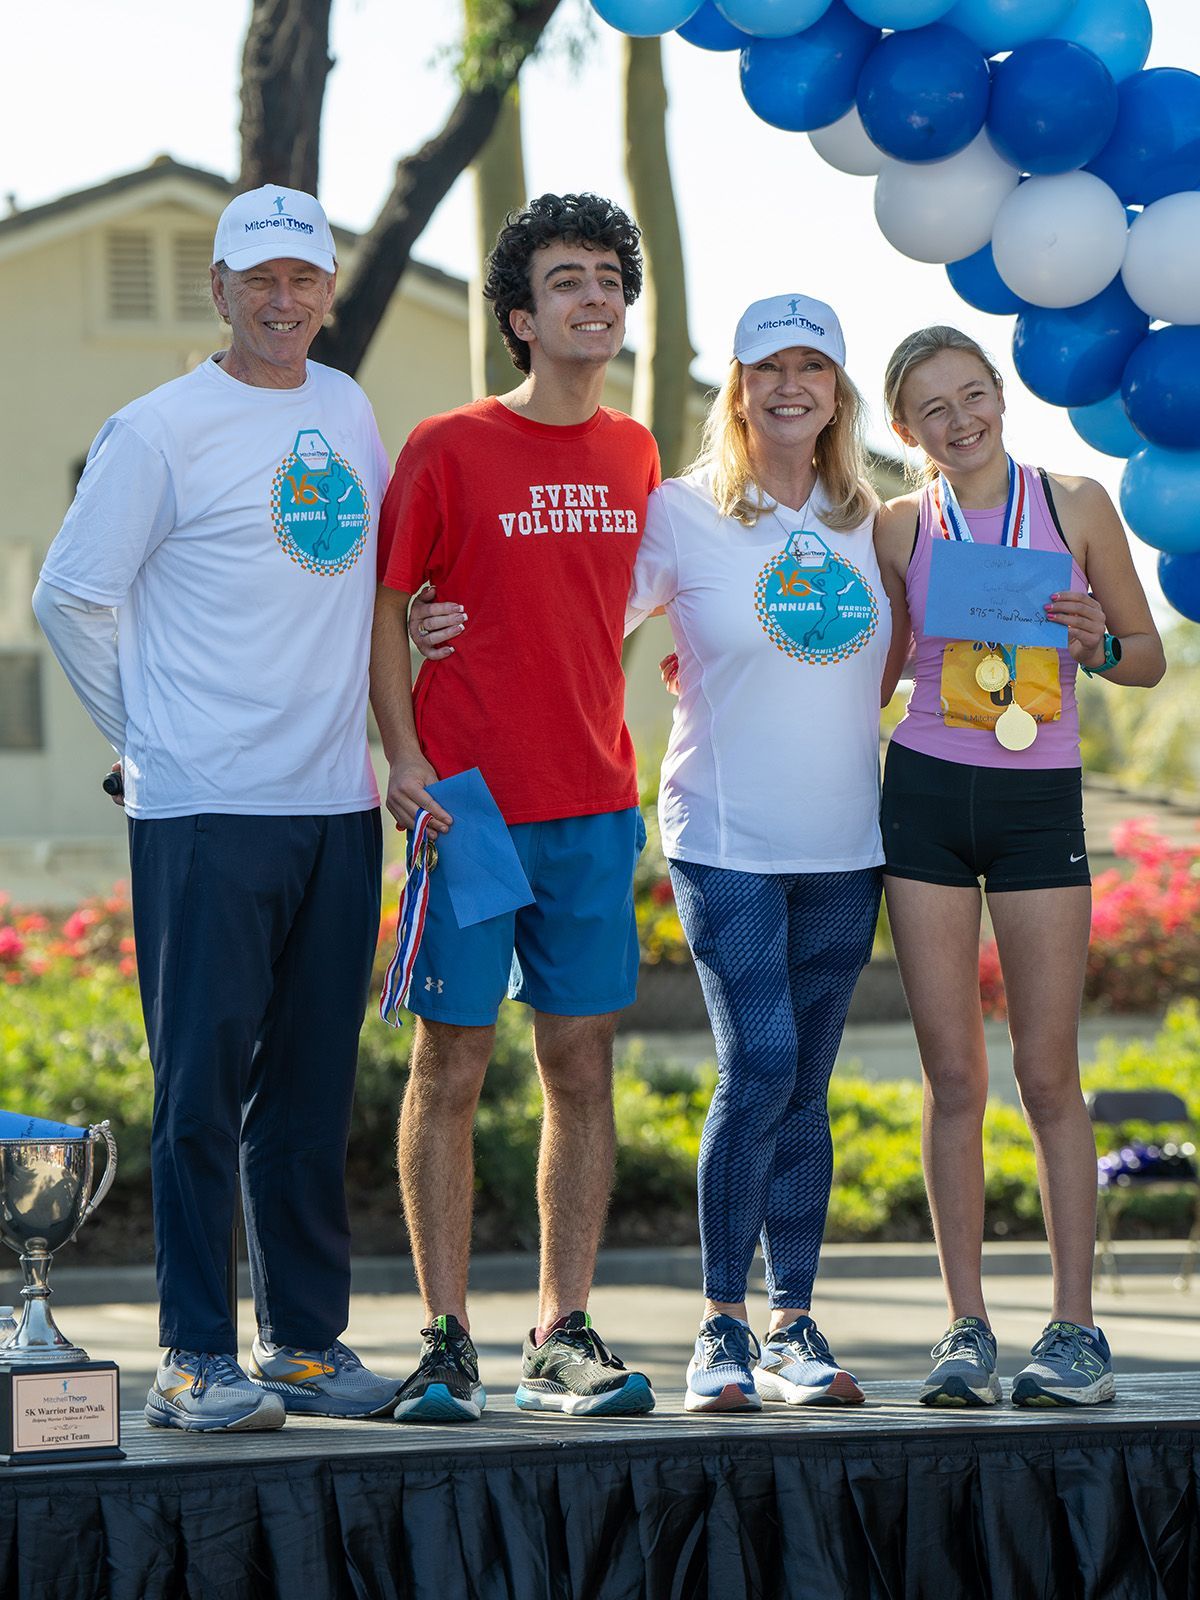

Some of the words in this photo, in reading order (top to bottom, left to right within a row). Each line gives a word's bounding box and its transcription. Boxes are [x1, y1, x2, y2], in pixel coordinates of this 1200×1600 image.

[245, 218, 285, 232] Mitchell
[286, 218, 314, 234] Thorp
[757, 317, 798, 331] Mitchell
[799, 318, 825, 336] Thorp
[287, 475, 319, 504] 16
[529, 484, 608, 509] EVENT
[284, 511, 327, 522] ANNUAL
[341, 520, 363, 528] SPIRIT
[498, 509, 638, 537] VOLUNTEER
[776, 570, 812, 597] 16
[768, 602, 823, 612] ANNUAL
[838, 629, 865, 651] FESTIVAL
[68, 1395, 87, 1403] Thorp
[25, 1408, 36, 1417] 5K
[37, 1406, 67, 1415] Warrior
[69, 1404, 105, 1414] Run/Walk
[41, 1433, 69, 1443] Largest
[71, 1432, 90, 1441] Team
